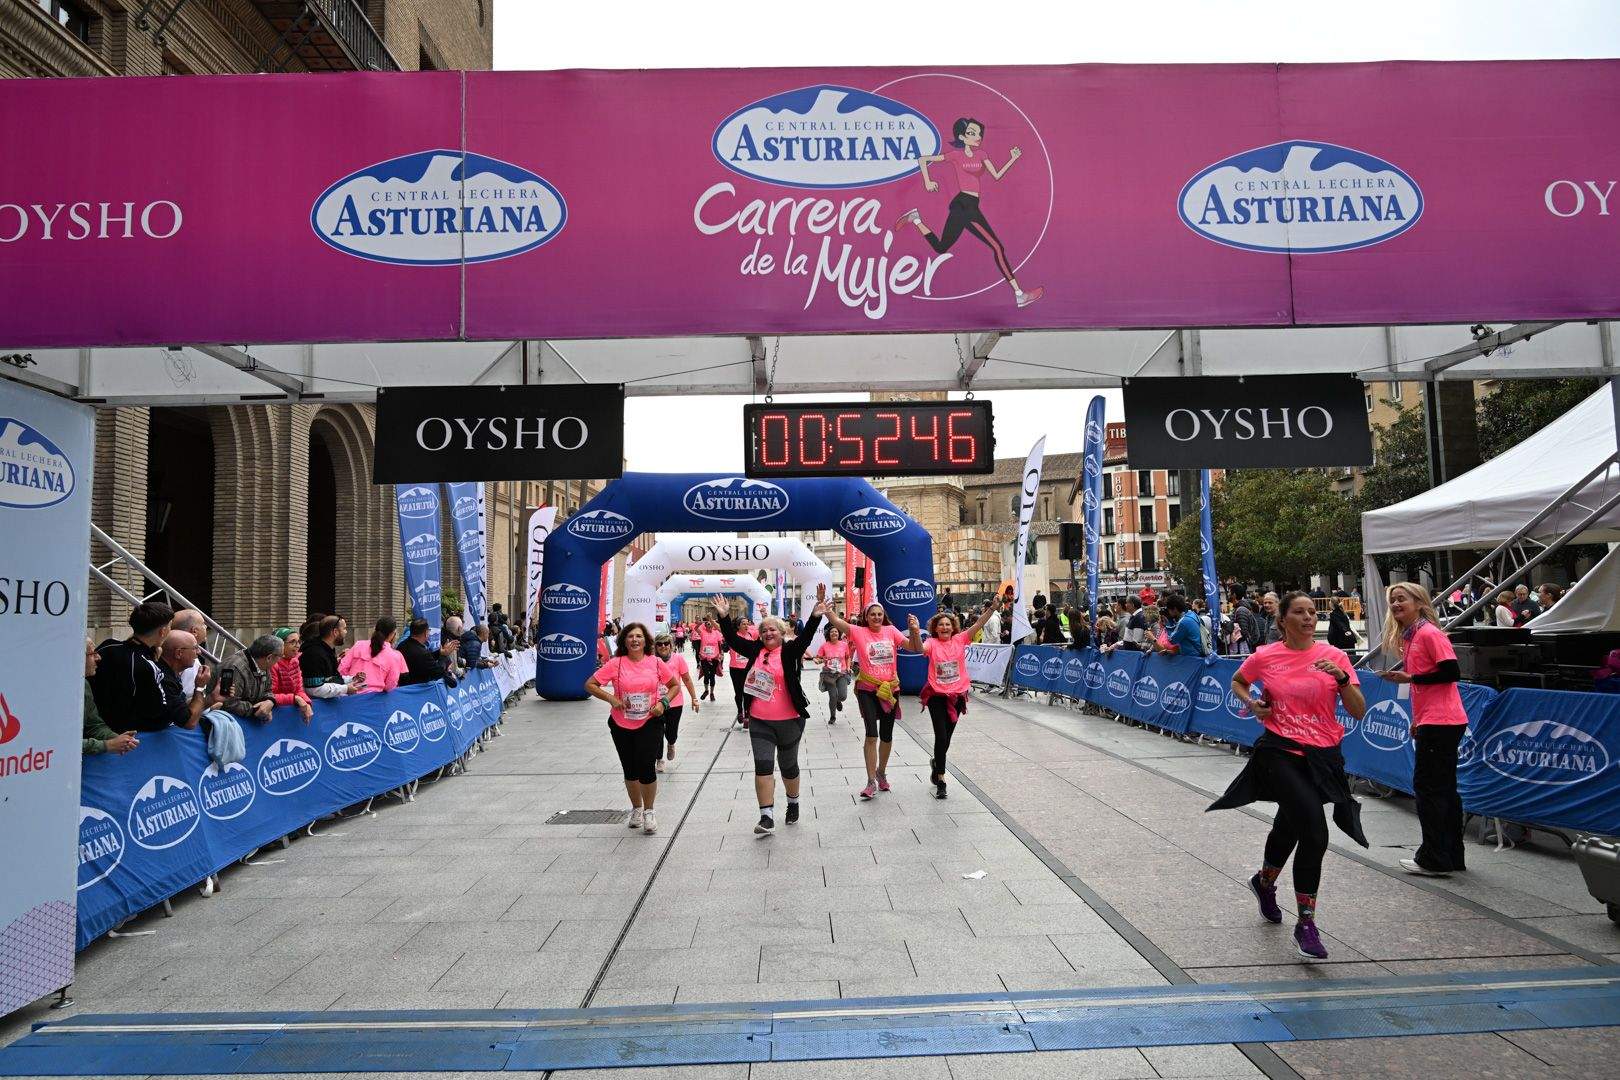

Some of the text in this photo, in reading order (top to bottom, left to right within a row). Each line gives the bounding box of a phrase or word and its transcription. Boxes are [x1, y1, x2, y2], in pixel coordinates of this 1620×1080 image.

[765, 120, 916, 132] CENTRAL LECHERA
[730, 122, 923, 163] ASTURIANA
[371, 188, 540, 202] CENTRAL LECHERA
[1234, 178, 1397, 192] CENTRAL LECHERA
[1544, 180, 1619, 218] OY
[331, 194, 547, 237] ASTURIANA
[694, 181, 882, 236] Carrera
[1198, 183, 1406, 226] ASTURIANA
[0, 199, 183, 243] OYSHO
[740, 229, 953, 321] de la Mujer
[416, 416, 589, 451] OYSHO
[1109, 428, 1127, 439] TIB
[1164, 405, 1334, 442] OYSHO
[21, 451, 63, 469] LECHERA
[691, 491, 782, 511] ASTURIANA
[570, 520, 630, 534] ASTURIANA
[845, 519, 902, 532] ASTURIANA
[688, 544, 770, 562] OYSHO
[888, 590, 933, 601] ASTURIANA
[330, 739, 379, 765] ASTURIANA
[1489, 740, 1597, 773] ASTURIANA
[262, 757, 319, 788] ASTURIANA
[203, 780, 254, 811] ASTURIANA
[81, 821, 112, 839] LECHERA
[136, 799, 199, 840] ASTURIANA
